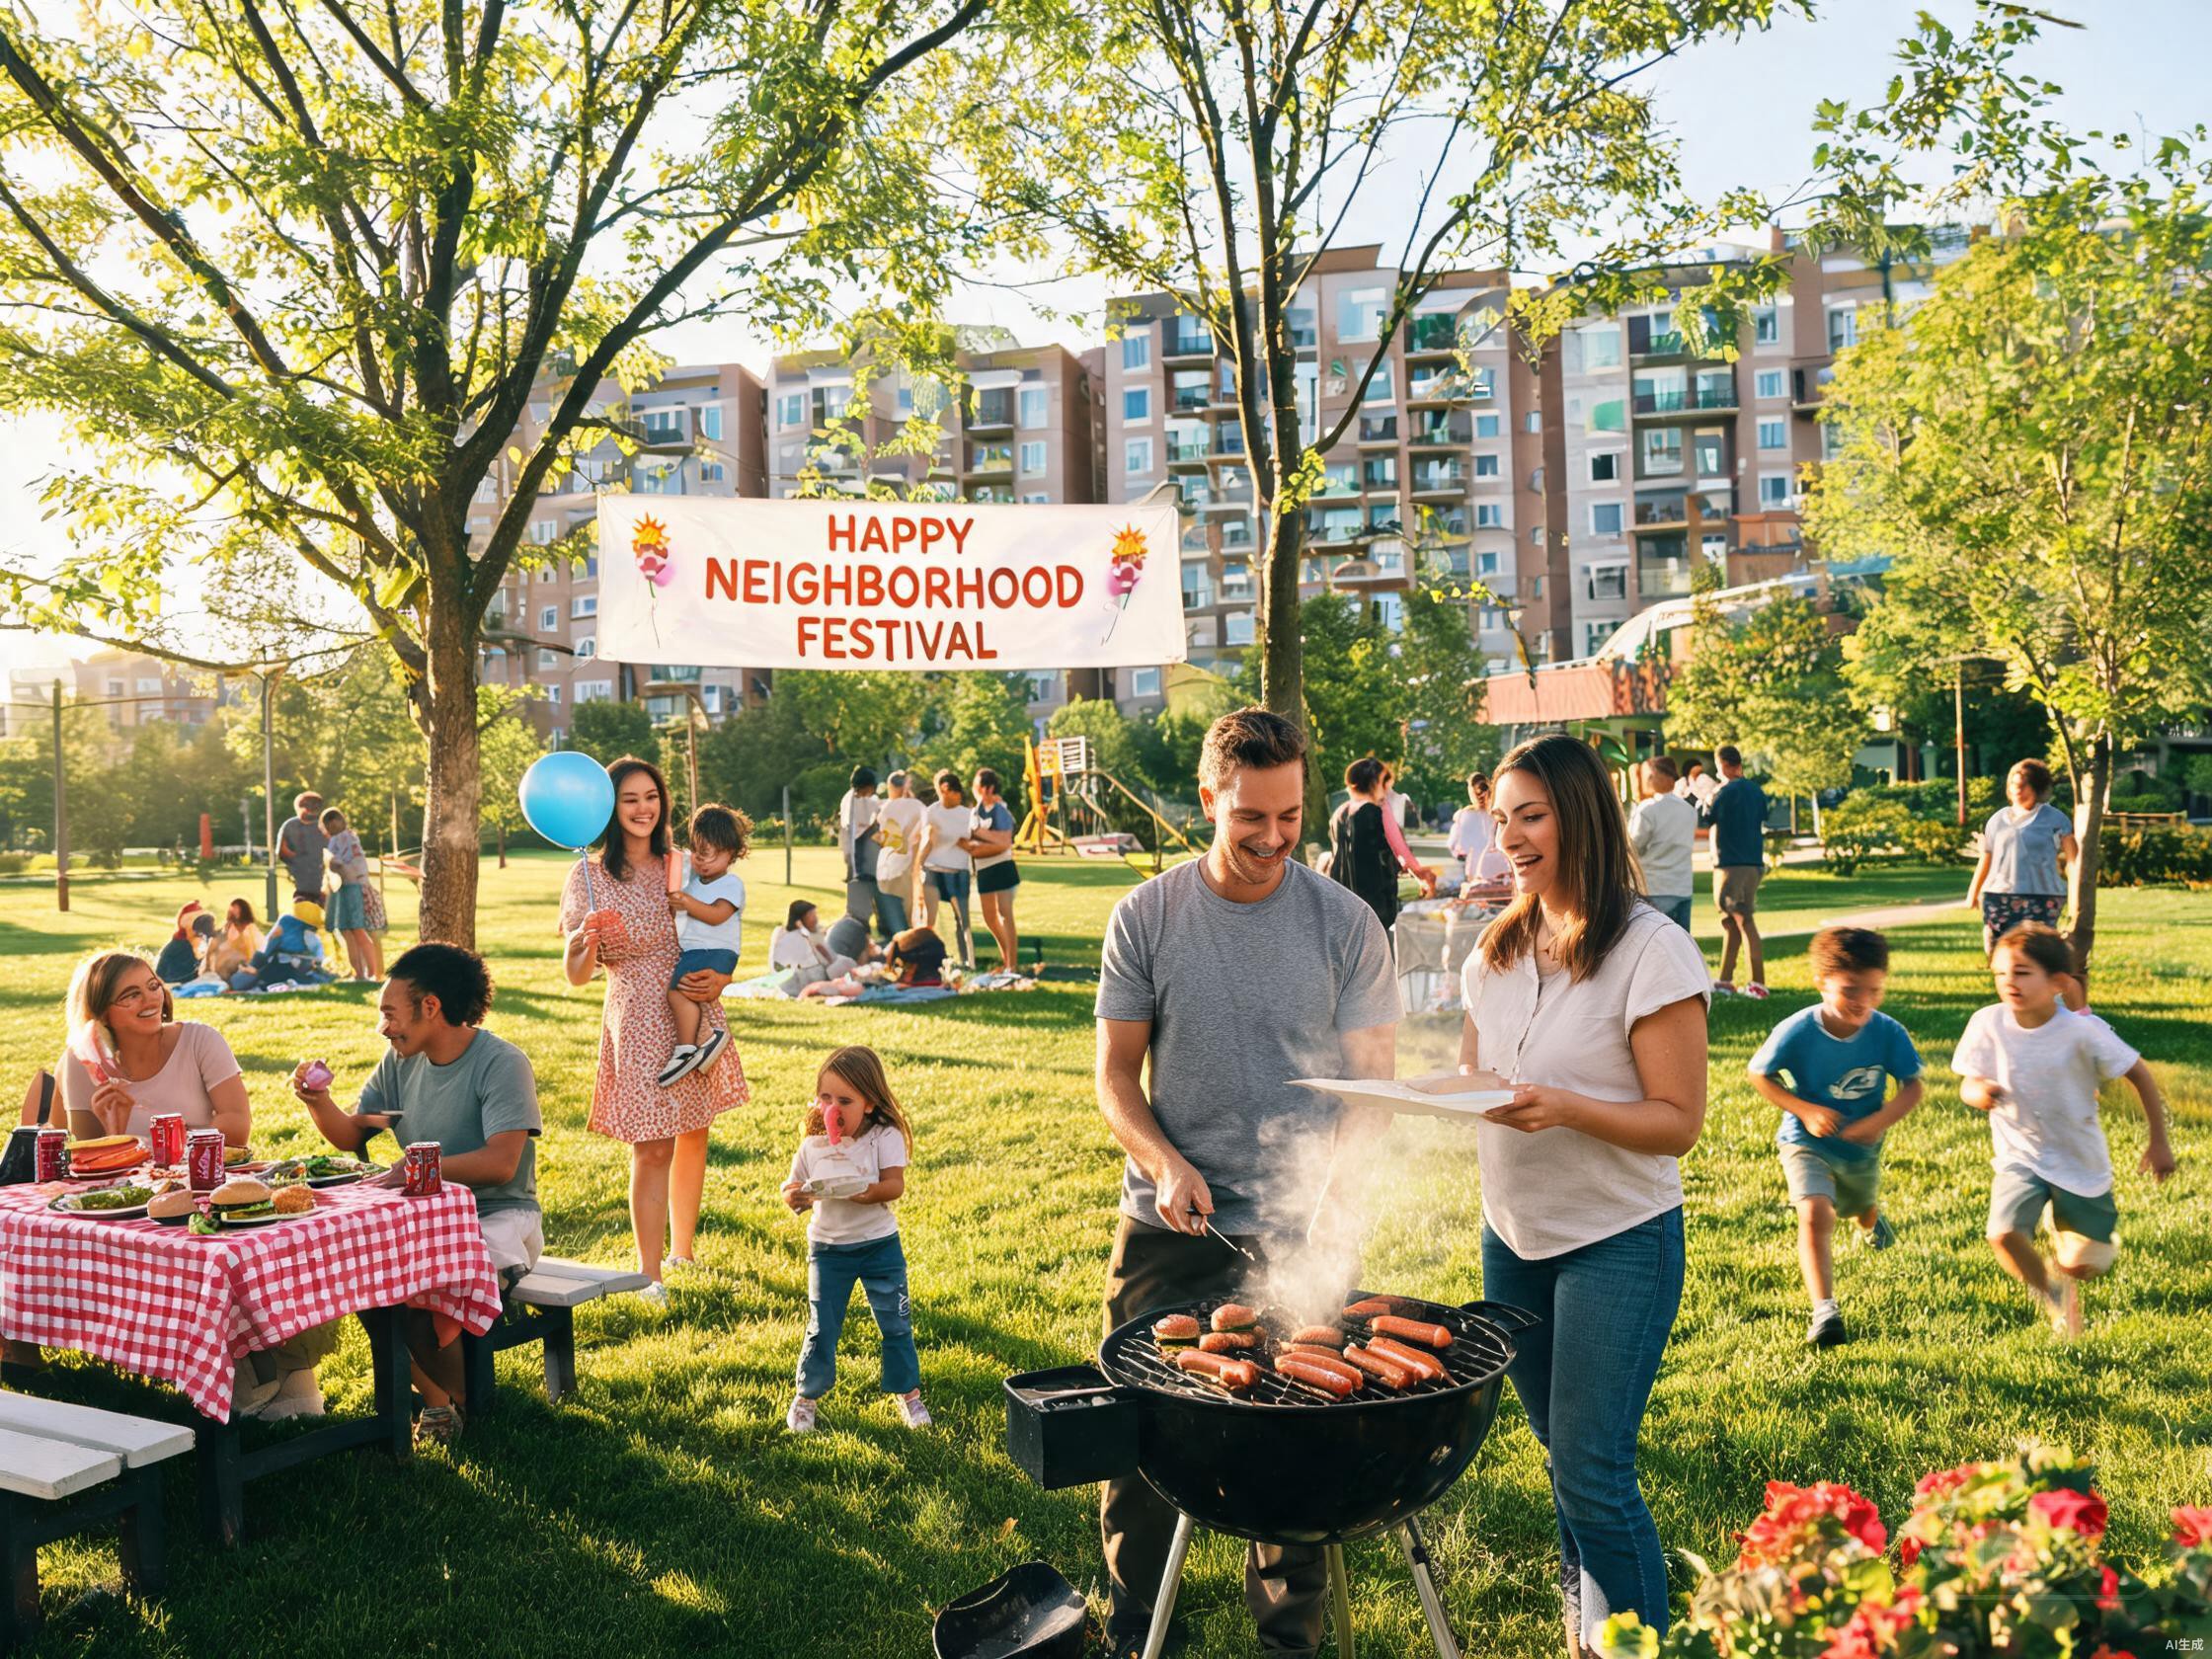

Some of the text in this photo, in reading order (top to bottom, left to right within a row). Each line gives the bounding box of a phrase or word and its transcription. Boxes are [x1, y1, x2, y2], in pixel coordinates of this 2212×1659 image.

[828, 514, 975, 554] HAPPY
[705, 556, 1084, 609] NEIGHBORHOOD
[797, 616, 998, 662] FESTIVAL
